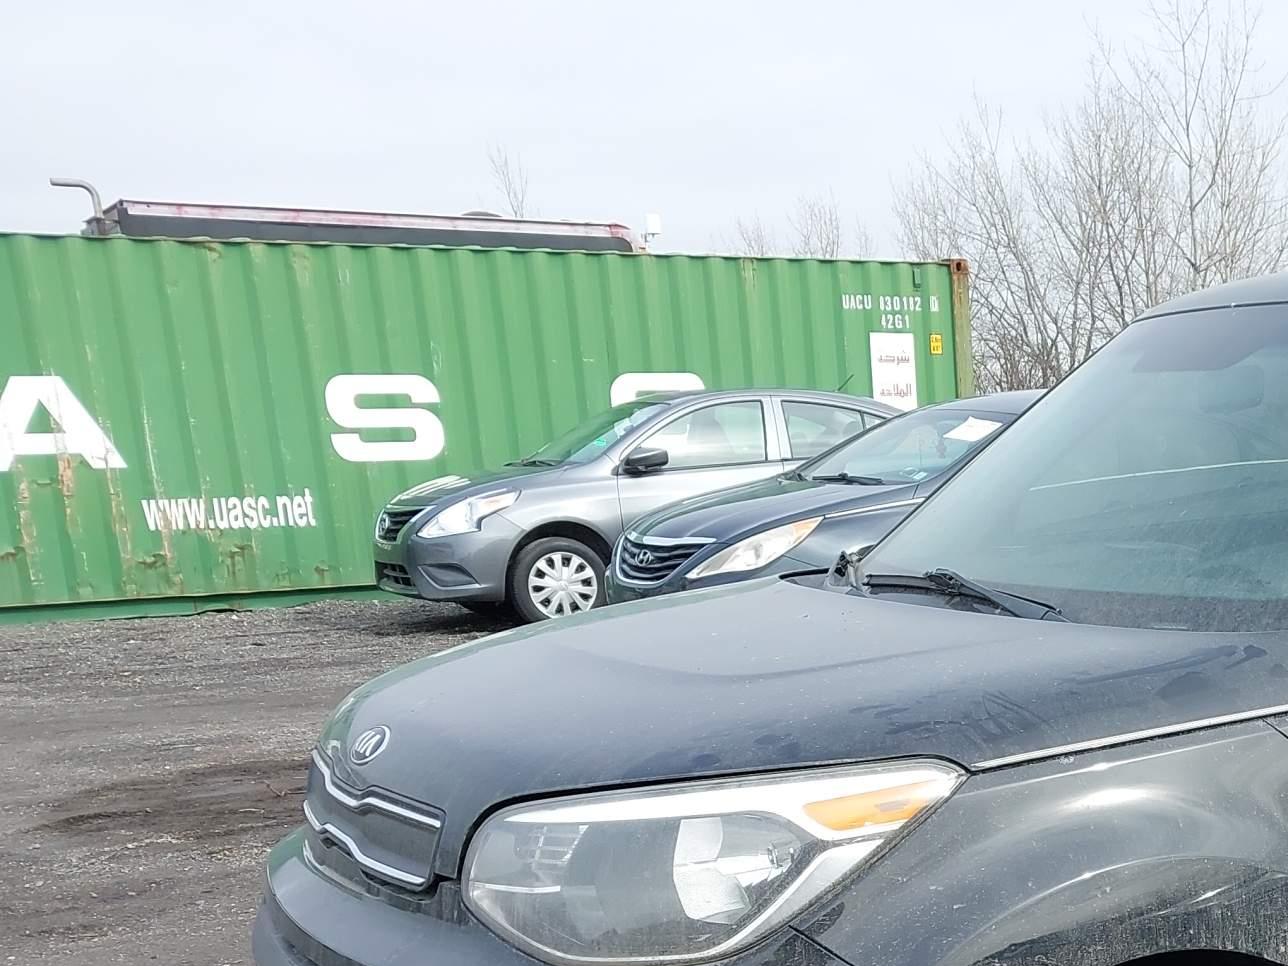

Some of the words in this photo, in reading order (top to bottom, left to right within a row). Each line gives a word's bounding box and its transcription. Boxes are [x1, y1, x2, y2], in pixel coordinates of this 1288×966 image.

[841, 293, 872, 310] UACU
[881, 314, 910, 329] 42G1
[141, 487, 317, 532] www.uasc.net
